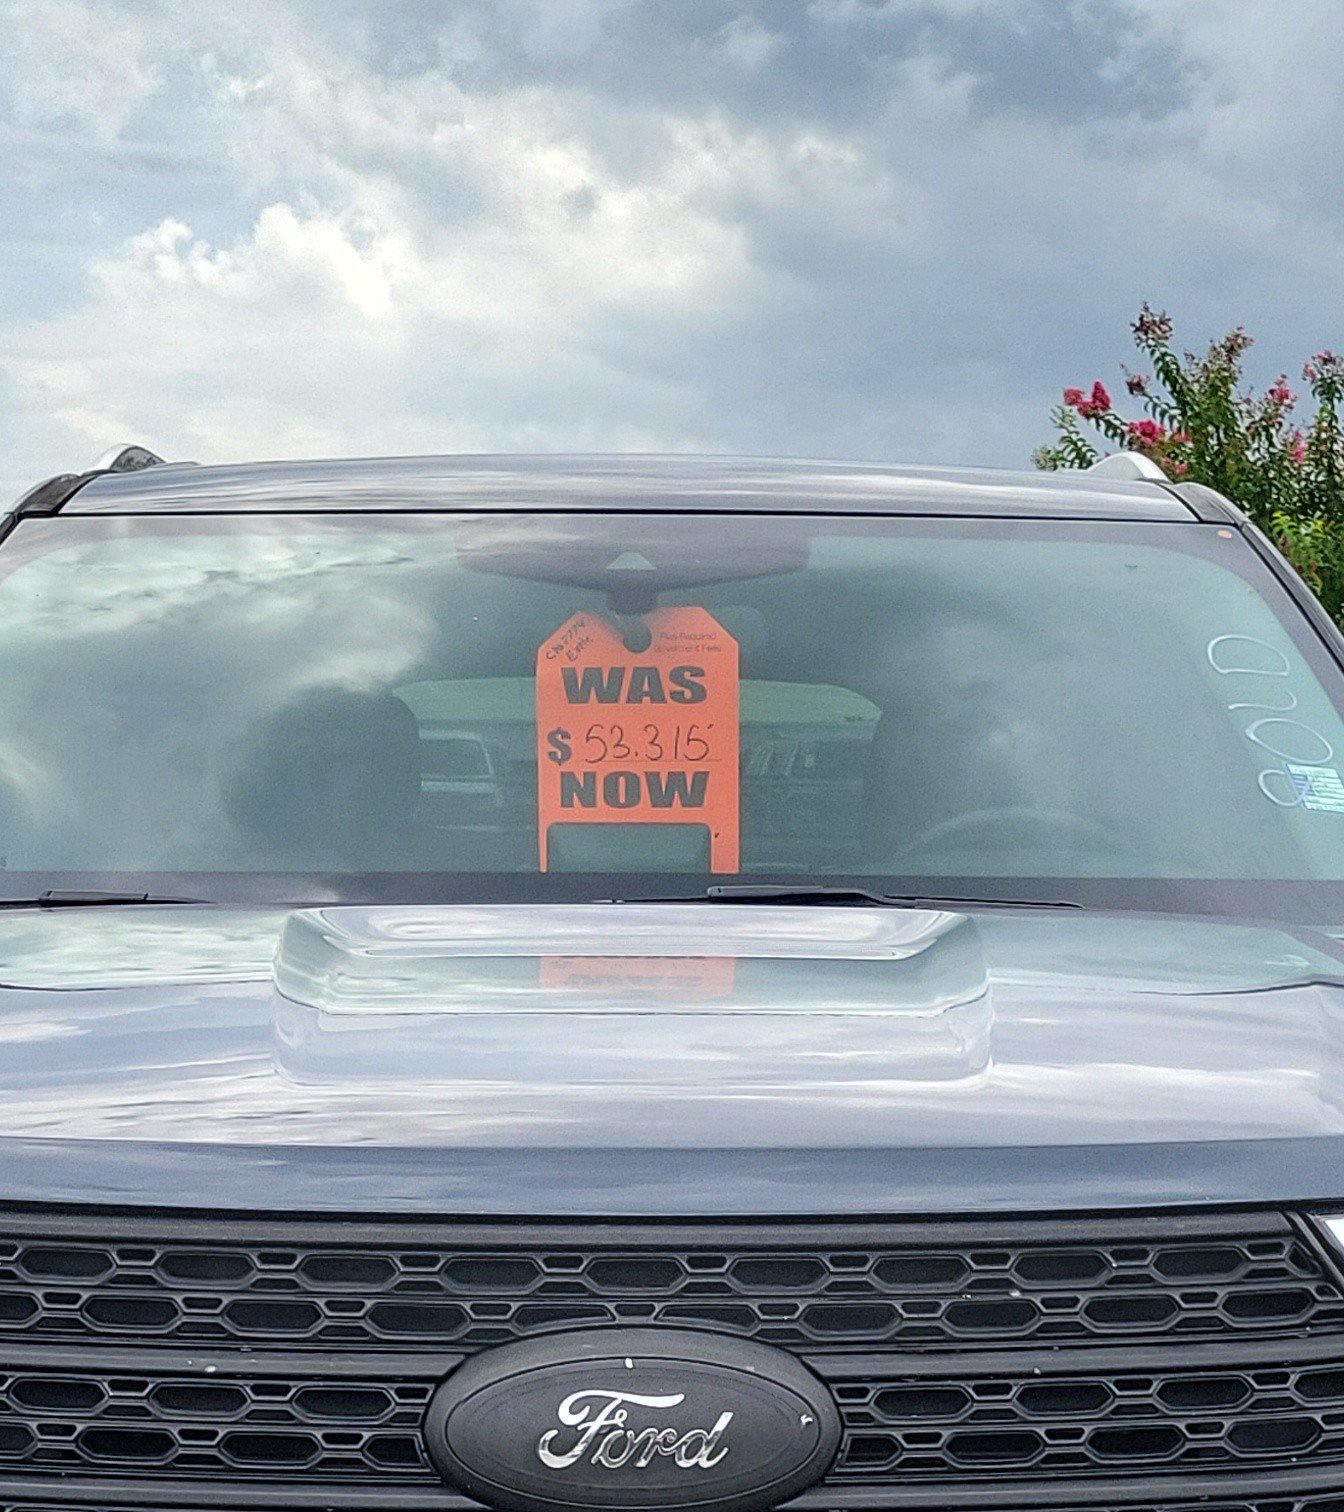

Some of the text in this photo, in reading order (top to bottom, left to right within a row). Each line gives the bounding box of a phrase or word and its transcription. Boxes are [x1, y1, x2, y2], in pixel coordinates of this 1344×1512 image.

[561, 665, 707, 704] WAS
[560, 771, 710, 808] NOW
[539, 1389, 733, 1468] Ford
